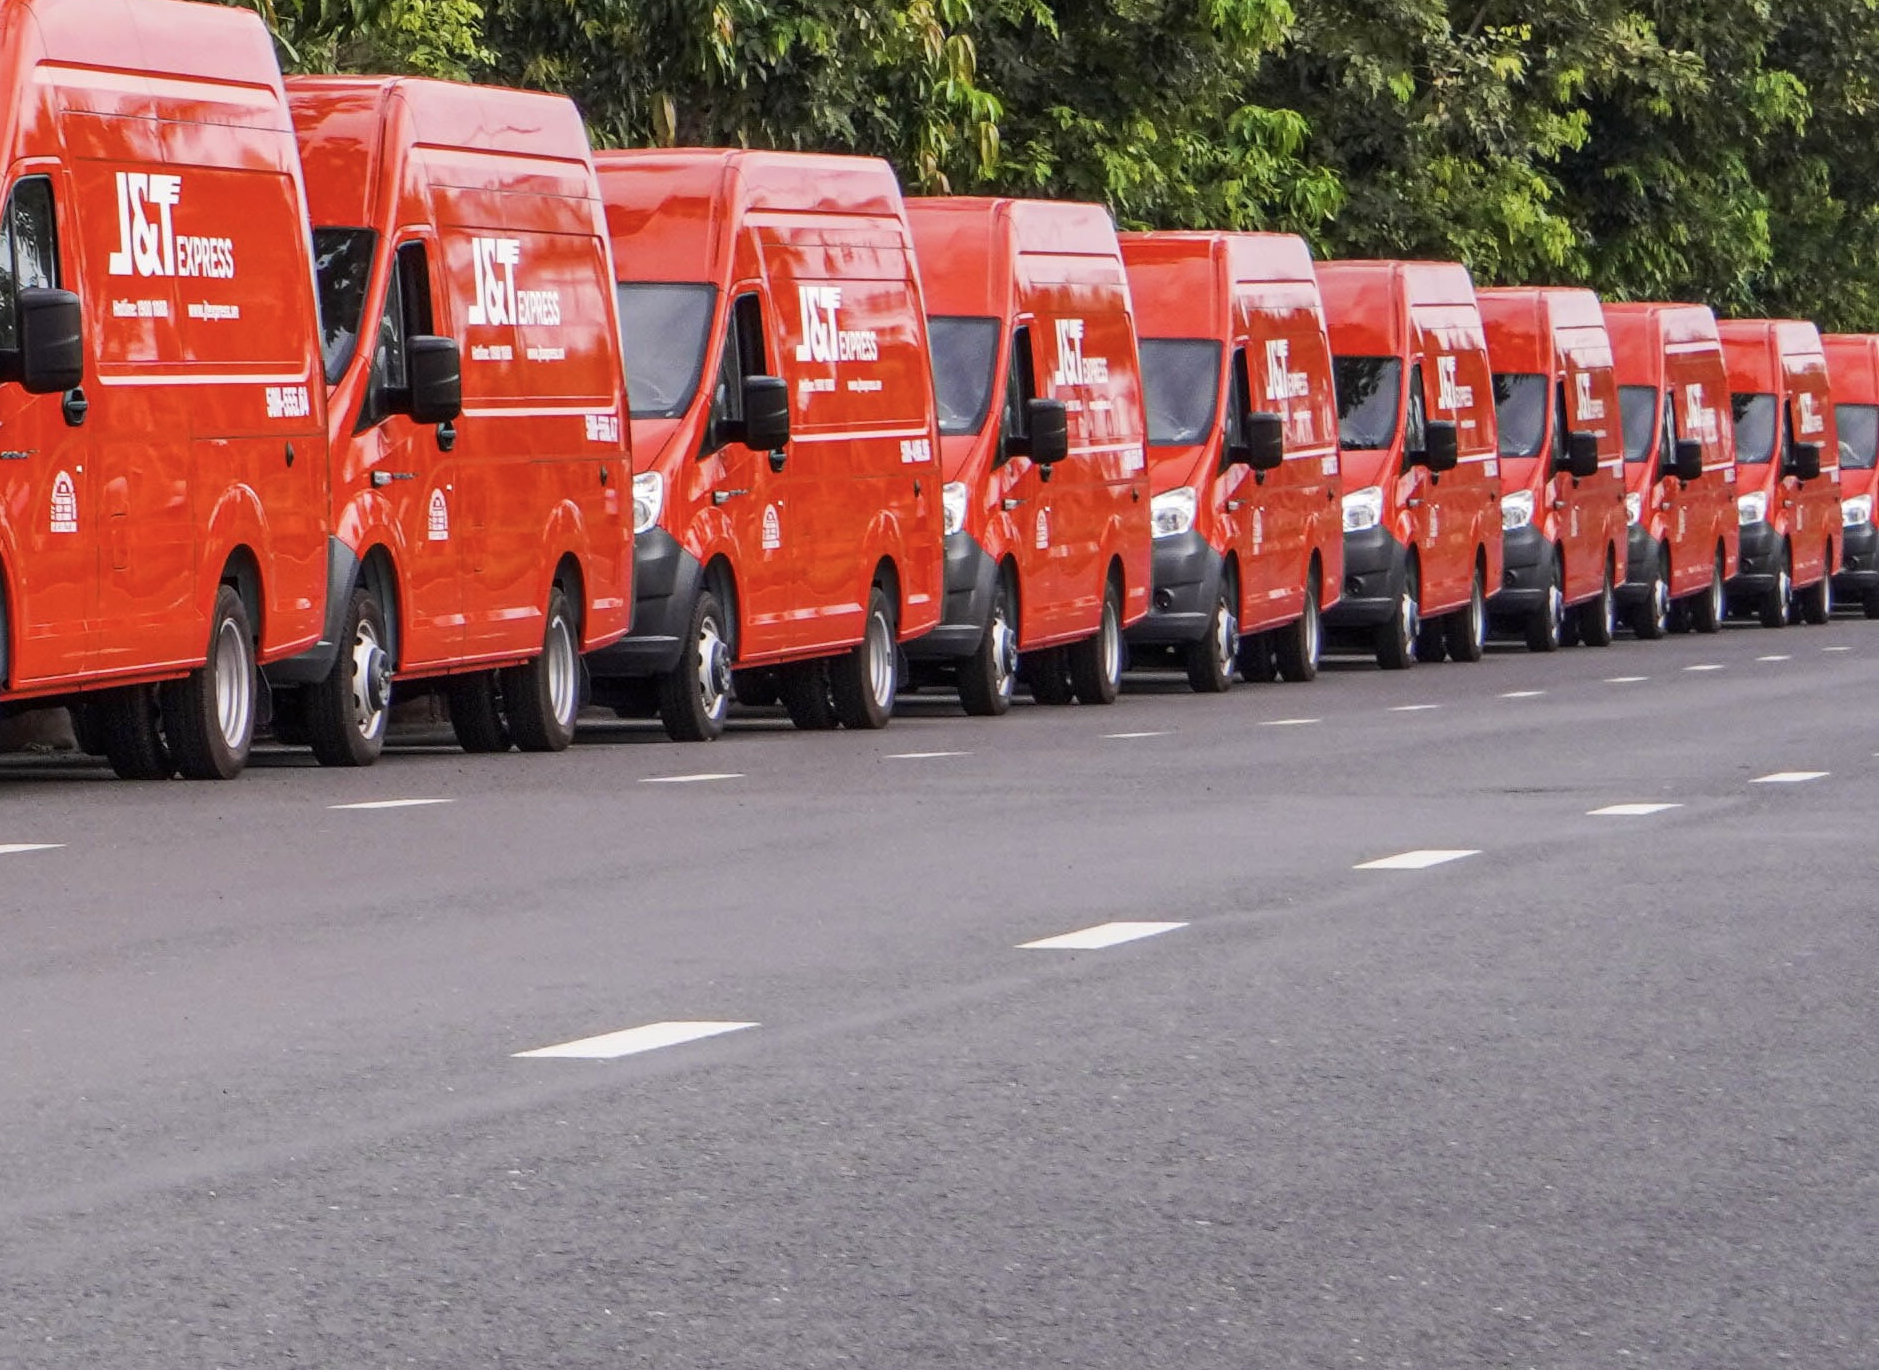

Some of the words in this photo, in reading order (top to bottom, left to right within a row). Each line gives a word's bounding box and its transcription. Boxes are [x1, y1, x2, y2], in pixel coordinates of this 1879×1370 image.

[109, 171, 181, 277] J&T
[176, 235, 234, 278] EXPRESS
[468, 237, 520, 326] J&T
[517, 290, 560, 325] EXPRESS
[796, 286, 842, 362] J&T
